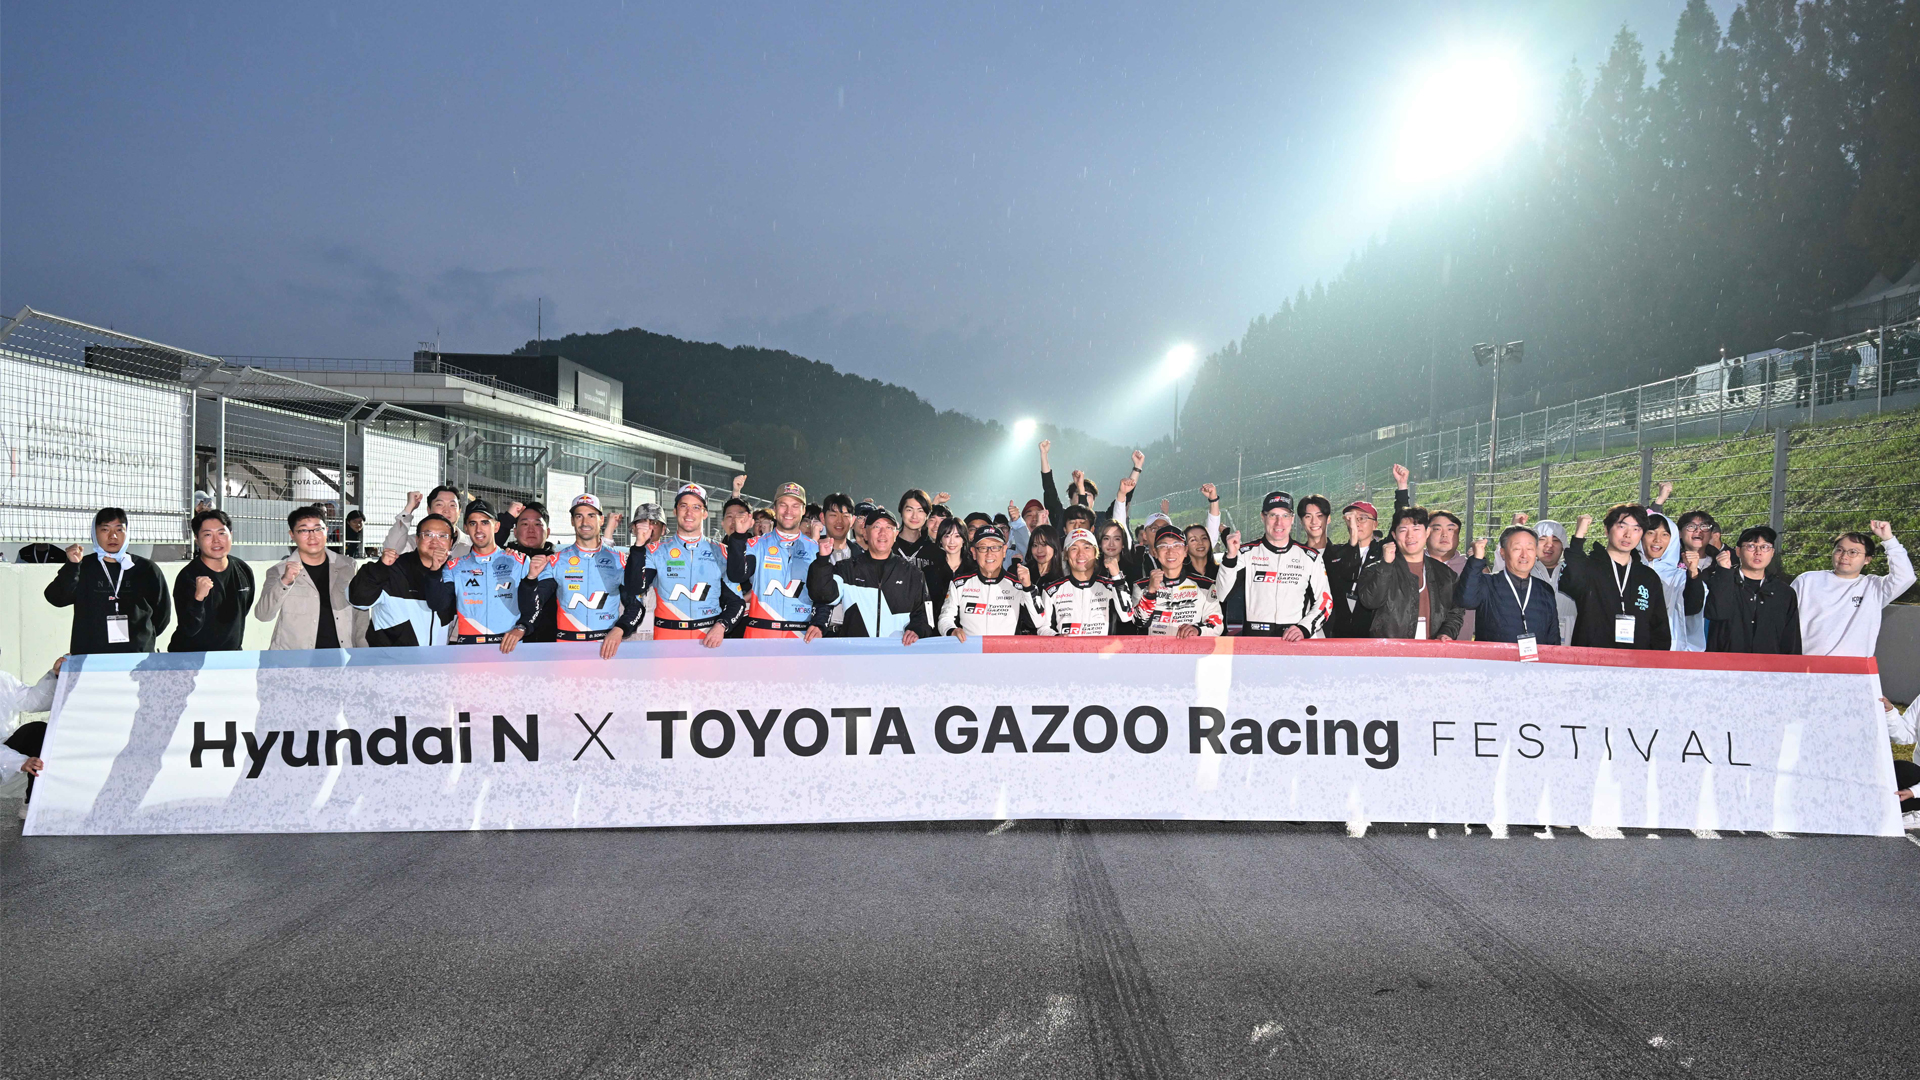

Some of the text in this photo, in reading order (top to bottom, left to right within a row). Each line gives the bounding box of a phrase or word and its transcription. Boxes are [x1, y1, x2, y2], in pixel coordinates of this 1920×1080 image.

[1254, 575, 1276, 583] GR
[965, 606, 985, 615] GR
[1062, 627, 1081, 635] GR
[189, 704, 1752, 779] Hyundai N X TOYOTA GAZOO Racing FESTIVAL
